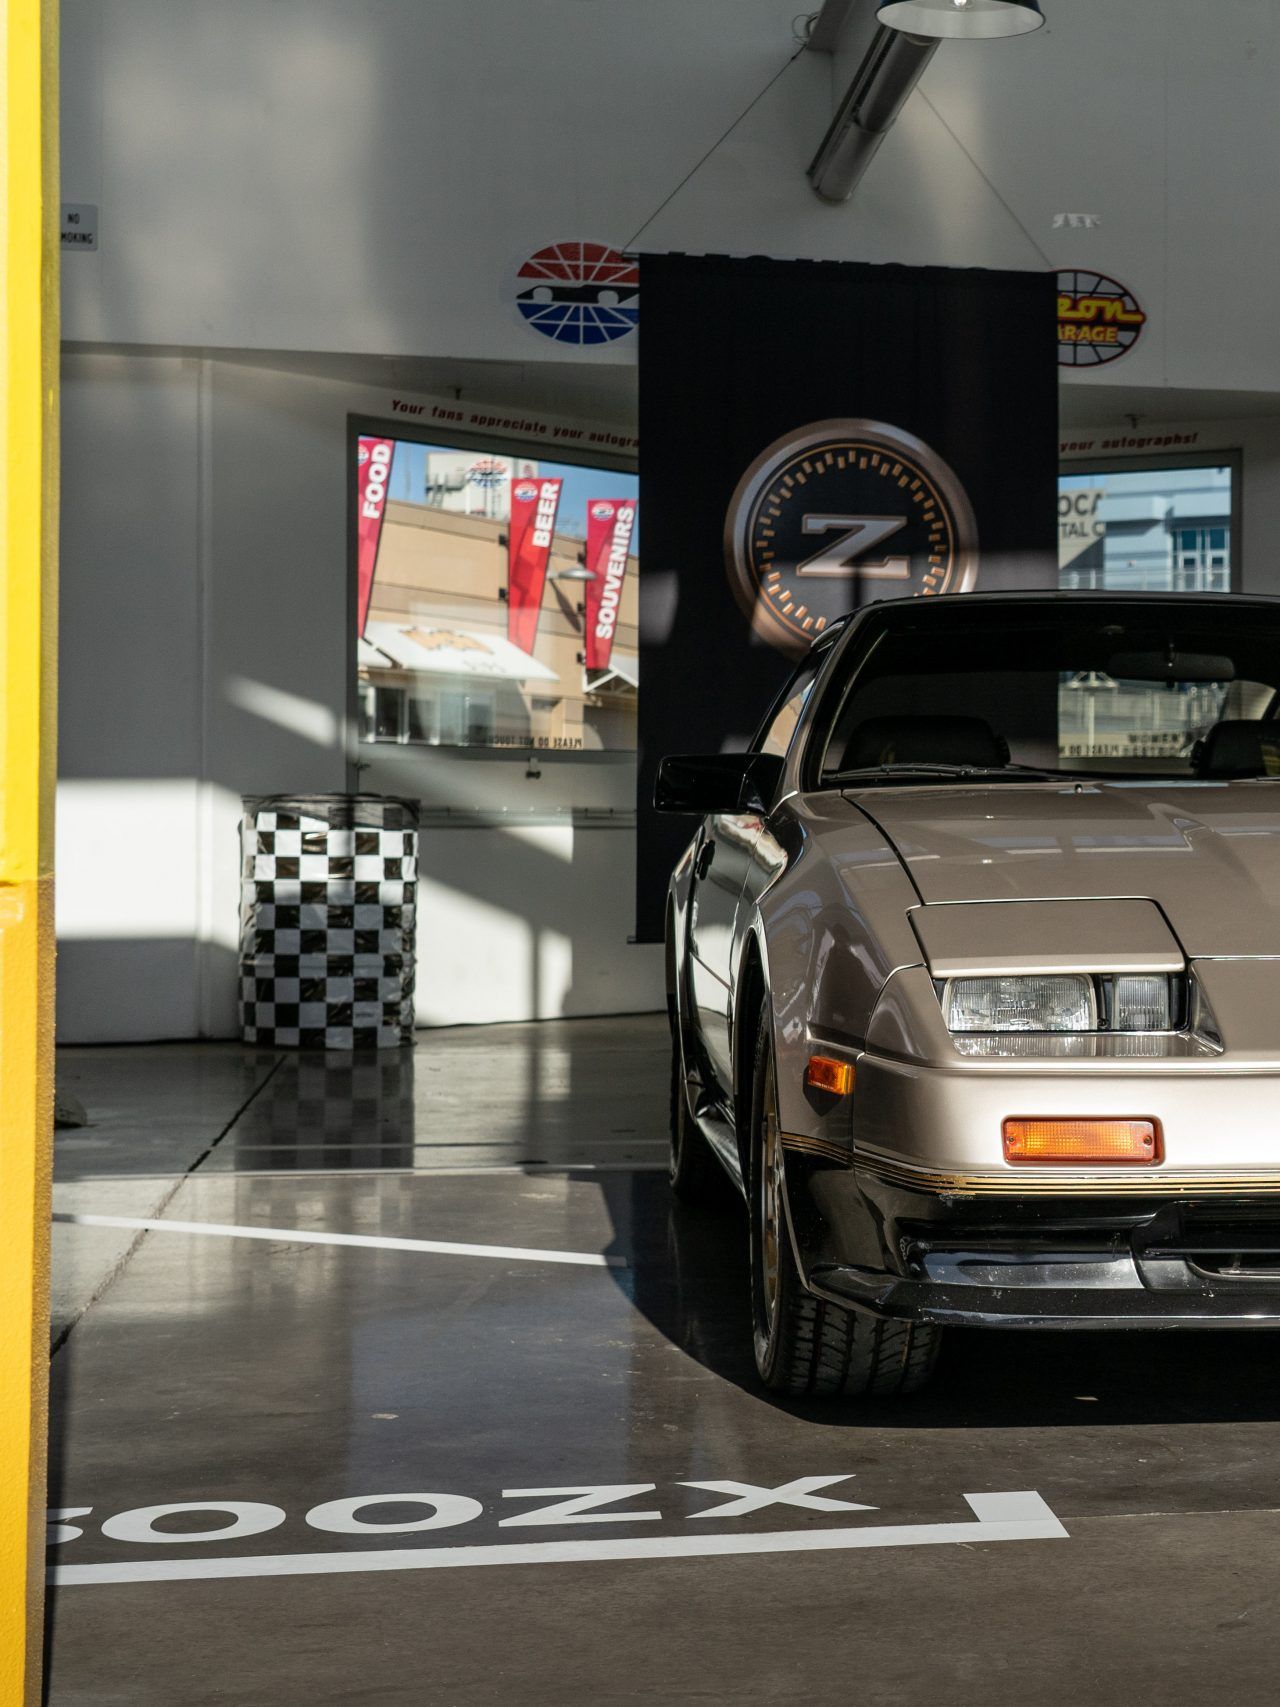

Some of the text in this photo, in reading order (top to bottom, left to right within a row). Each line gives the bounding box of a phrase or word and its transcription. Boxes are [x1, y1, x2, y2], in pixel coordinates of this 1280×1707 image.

[67, 213, 80, 225] NO
[392, 400, 425, 415] Your
[431, 406, 464, 421] fans
[470, 414, 547, 435] appreciate
[553, 426, 584, 440] your
[1059, 432, 1199, 453] your autographs!
[362, 443, 391, 519] FOOD
[532, 481, 559, 547] BEER
[595, 507, 634, 640] SOUVENIRS
[796, 513, 911, 579] Z
